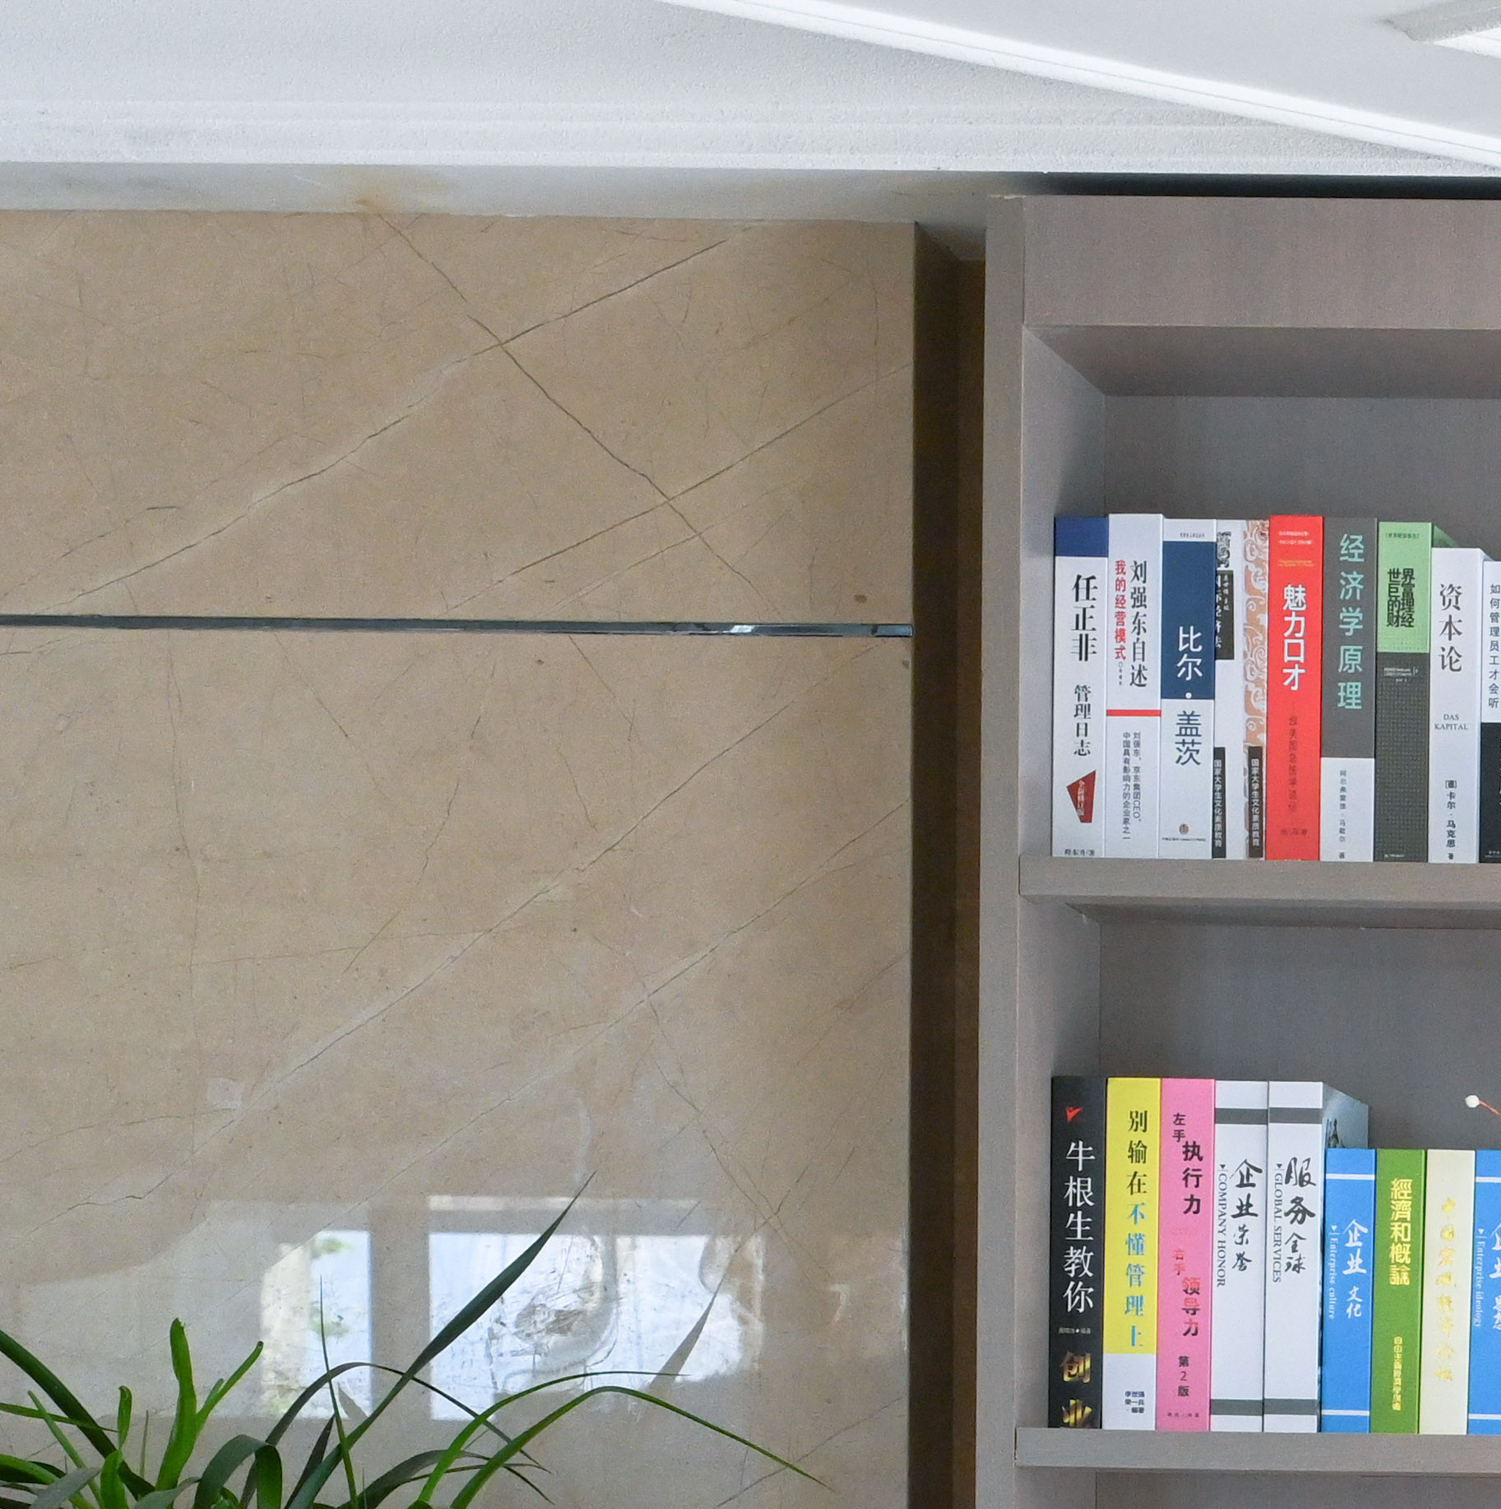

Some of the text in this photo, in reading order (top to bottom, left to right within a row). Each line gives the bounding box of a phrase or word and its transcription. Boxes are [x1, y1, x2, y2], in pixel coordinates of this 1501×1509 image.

[1070, 574, 1098, 662] 任正非
[1114, 560, 1127, 660] 我的经营模式
[1283, 584, 1306, 691] 魅力口才
[1338, 533, 1365, 710] 经济学原理
[1438, 583, 1464, 672] 资本论
[1487, 584, 1500, 709] 如何管理员工才会听
[1434, 723, 1469, 731] KAPITAL
[1443, 713, 1460, 721] DAS
[1122, 731, 1131, 840] 中国具有影响力的企业家之一
[1063, 1140, 1095, 1313] 牛根生教你
[1125, 1110, 1148, 1347] 别输在不懂管理上
[1182, 1141, 1203, 1215] 执行力
[1216, 1173, 1228, 1288] COMPANY HONOR
[1272, 1172, 1284, 1284] GLOBAL SERVICES
[1177, 1355, 1190, 1398] 第2版
